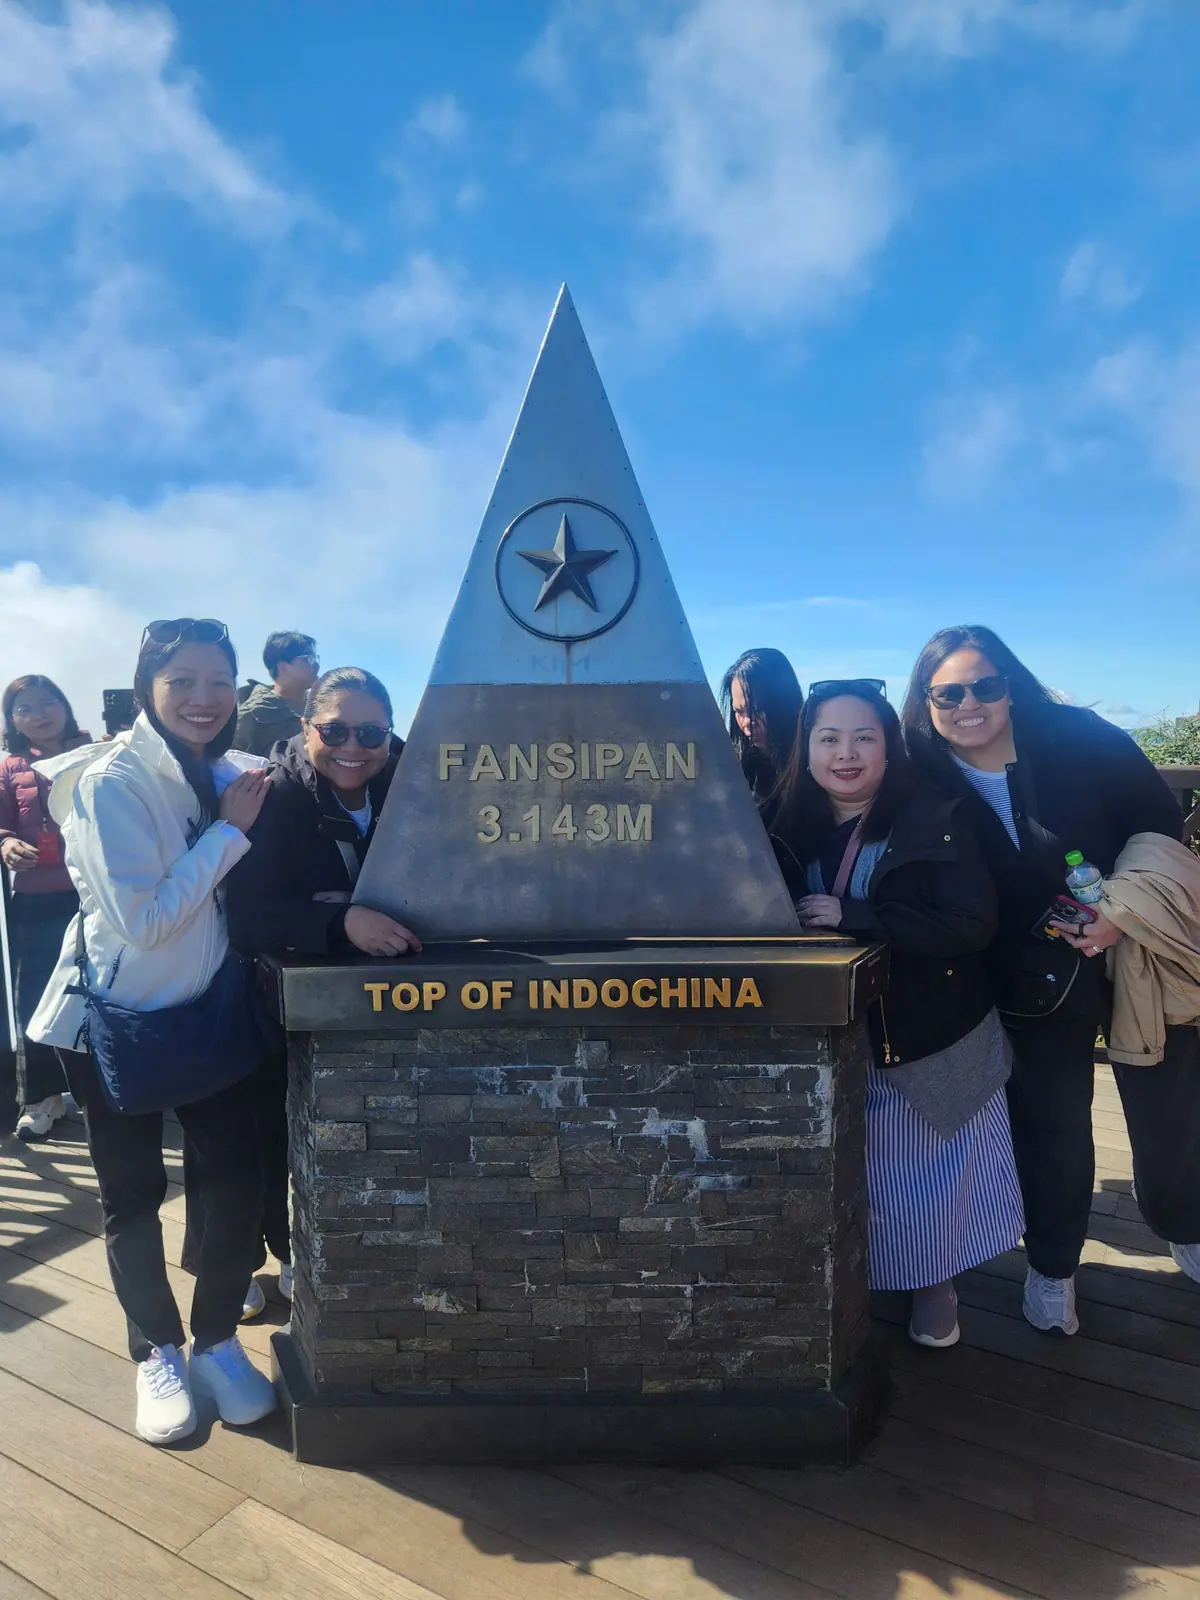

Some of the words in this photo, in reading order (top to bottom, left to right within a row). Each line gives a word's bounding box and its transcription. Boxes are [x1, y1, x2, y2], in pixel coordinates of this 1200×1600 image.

[437, 742, 697, 782] FANSIPAN
[477, 803, 654, 844] 3.143M
[364, 981, 447, 1012] TOP
[461, 980, 514, 1011] OF
[528, 977, 764, 1010] INDOCHINA
